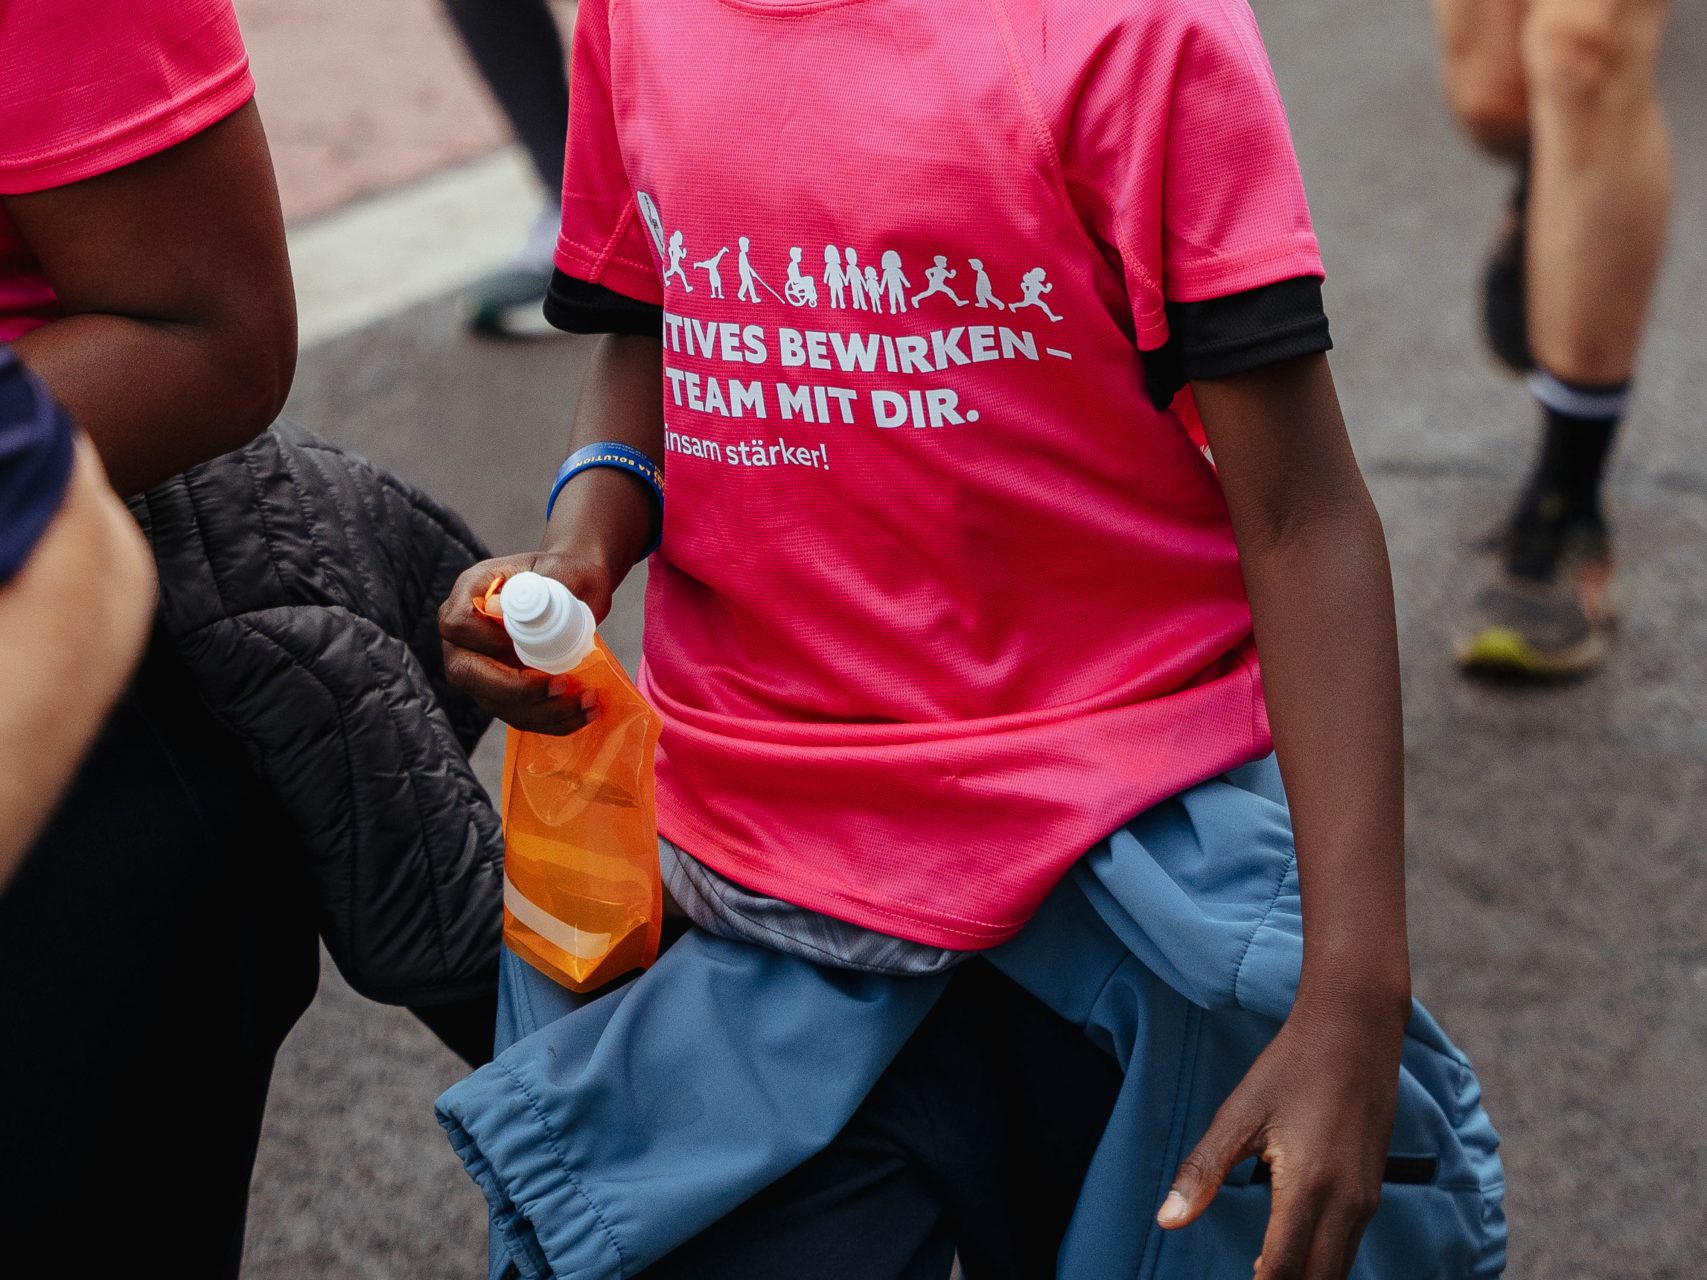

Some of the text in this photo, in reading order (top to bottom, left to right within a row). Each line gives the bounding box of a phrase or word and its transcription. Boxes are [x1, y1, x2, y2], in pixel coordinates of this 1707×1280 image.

[779, 326, 1039, 374] BEWIRKEN
[665, 366, 980, 429] TEAM MIT DIR.
[725, 437, 830, 470] stärker!
